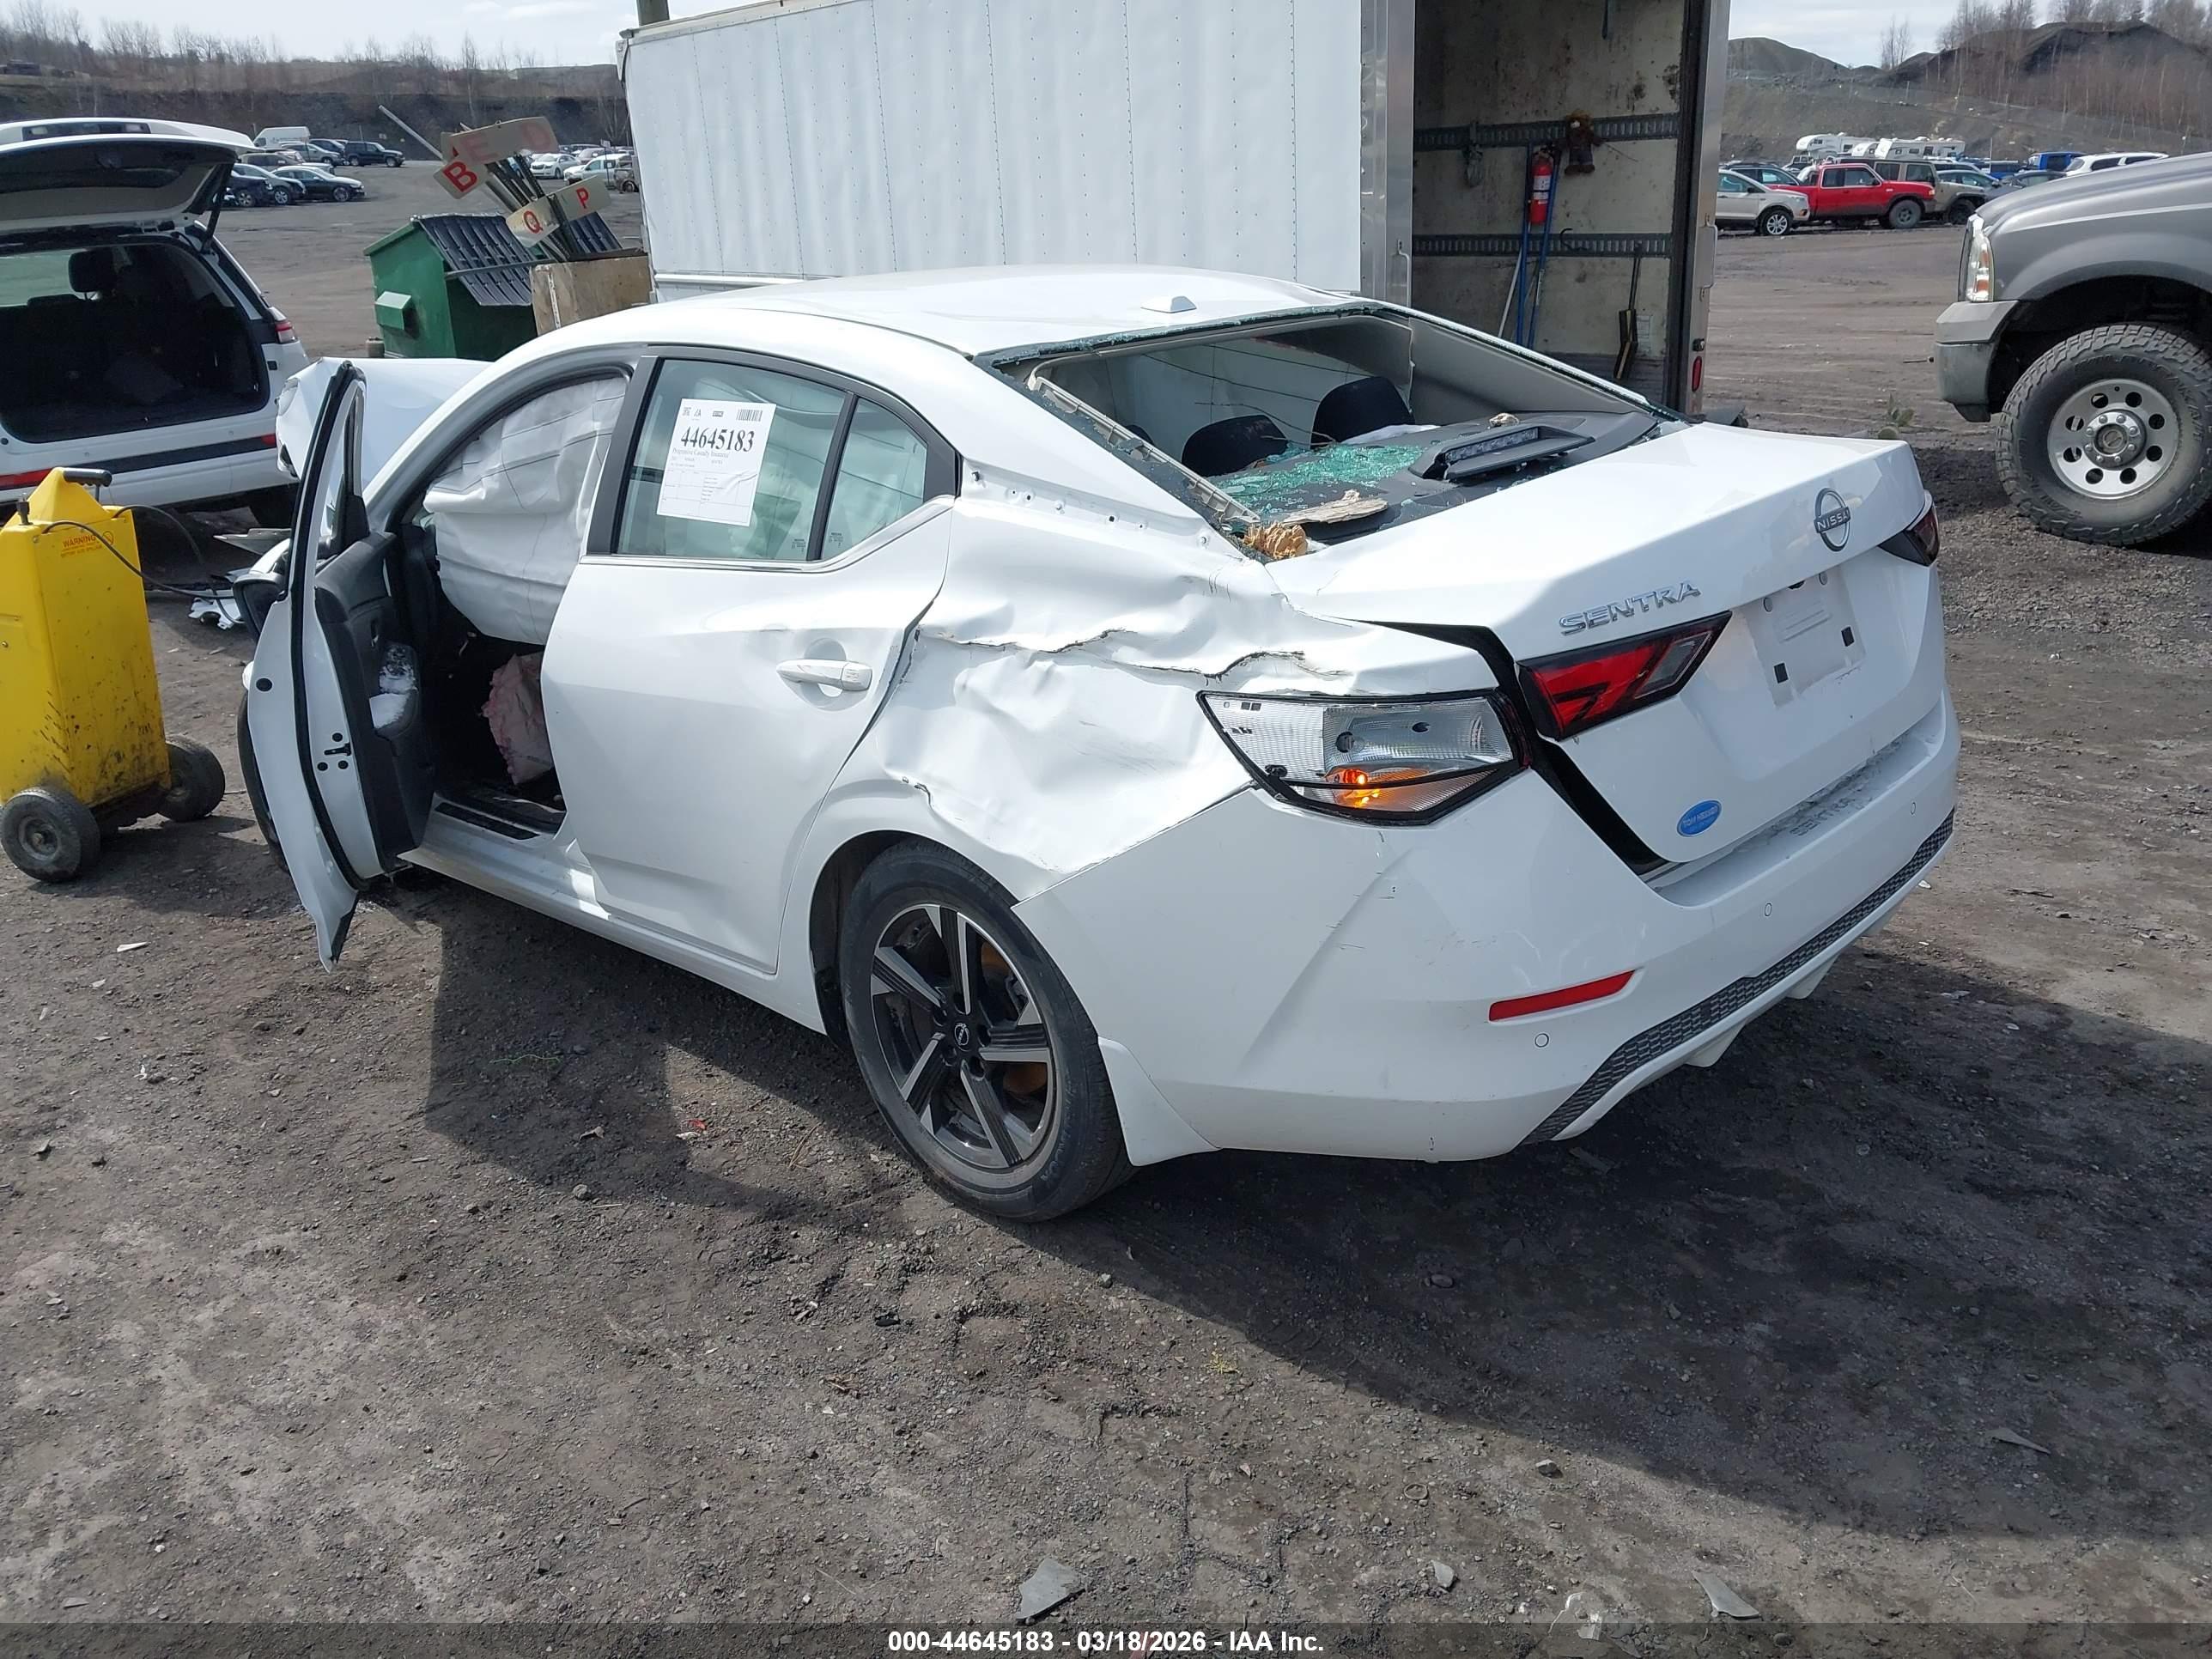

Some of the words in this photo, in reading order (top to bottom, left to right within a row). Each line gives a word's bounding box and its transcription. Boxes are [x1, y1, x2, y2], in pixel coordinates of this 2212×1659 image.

[442, 161, 478, 193] B
[575, 187, 590, 210] P
[523, 210, 544, 234] Q
[680, 426, 756, 453] 44645183
[63, 535, 97, 548] WARNING
[1559, 581, 1702, 636] SENTRA
